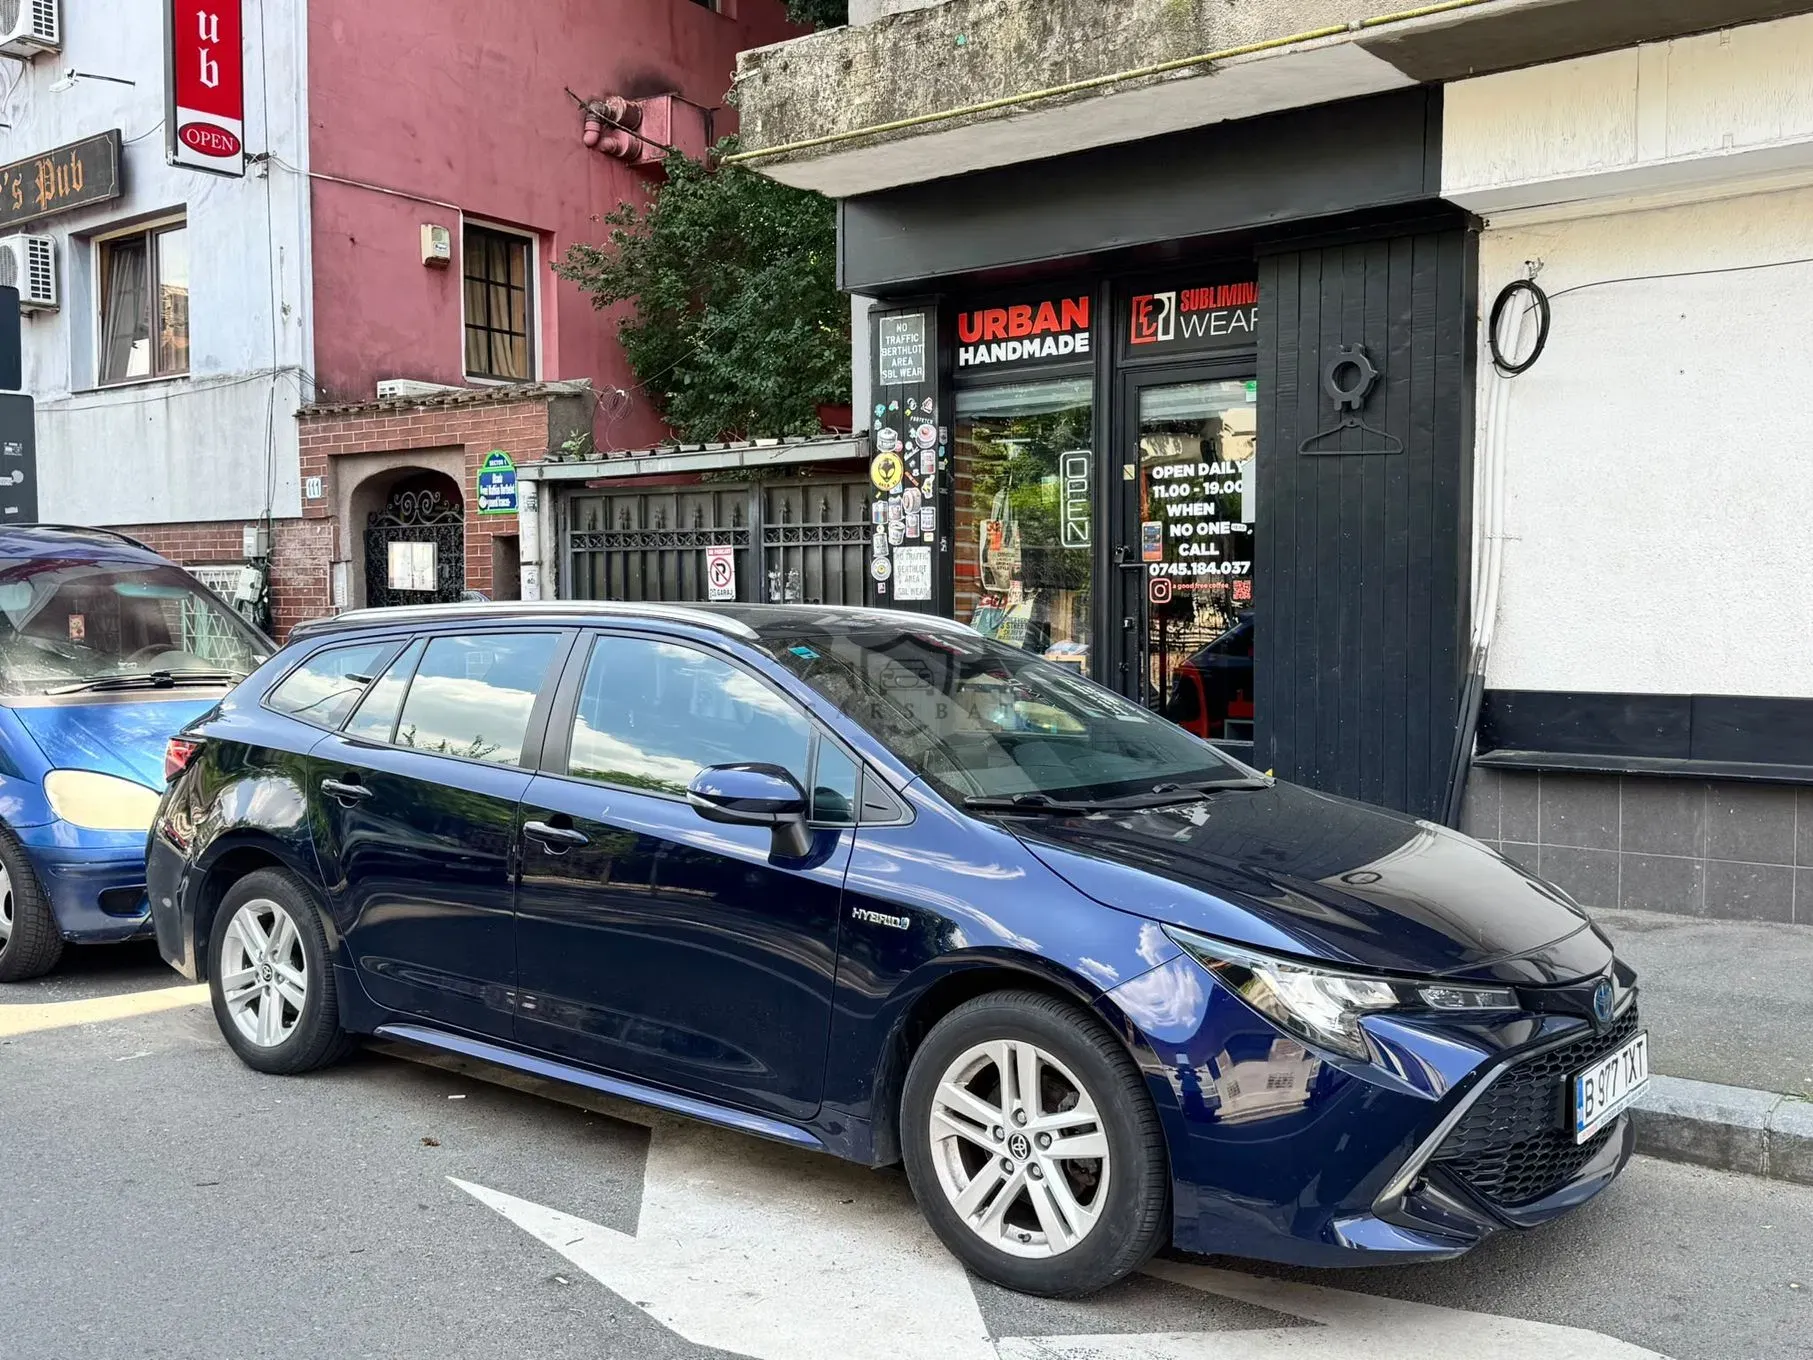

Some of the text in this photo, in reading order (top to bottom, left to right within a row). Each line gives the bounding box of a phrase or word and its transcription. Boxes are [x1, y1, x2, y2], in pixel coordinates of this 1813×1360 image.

[186, 128, 234, 152] OPEN
[35, 150, 84, 211] Pub
[896, 323, 908, 332] NO
[958, 296, 1089, 343] URBAN
[885, 333, 919, 345] TRAFFIC
[881, 344, 924, 356] BERTHLOT
[958, 332, 1090, 366] HANDMADE
[891, 356, 913, 367] AREA
[882, 367, 923, 379] SBL WEAR
[1152, 461, 1247, 479] OPEN DAILY
[1152, 483, 1191, 498] 11.00
[1203, 480, 1242, 495] 19.00
[1066, 458, 1089, 541] OPEN
[1166, 502, 1215, 517] WHEN
[1169, 524, 1193, 537] NO
[1196, 521, 1231, 535] ONE
[1178, 542, 1219, 556] CALL
[1149, 561, 1251, 576] 0745.184.037
[852, 907, 901, 928] HYBRID
[1585, 1078, 1594, 1118] B
[1598, 1058, 1618, 1106] 977
[1622, 1041, 1643, 1087] TXT
